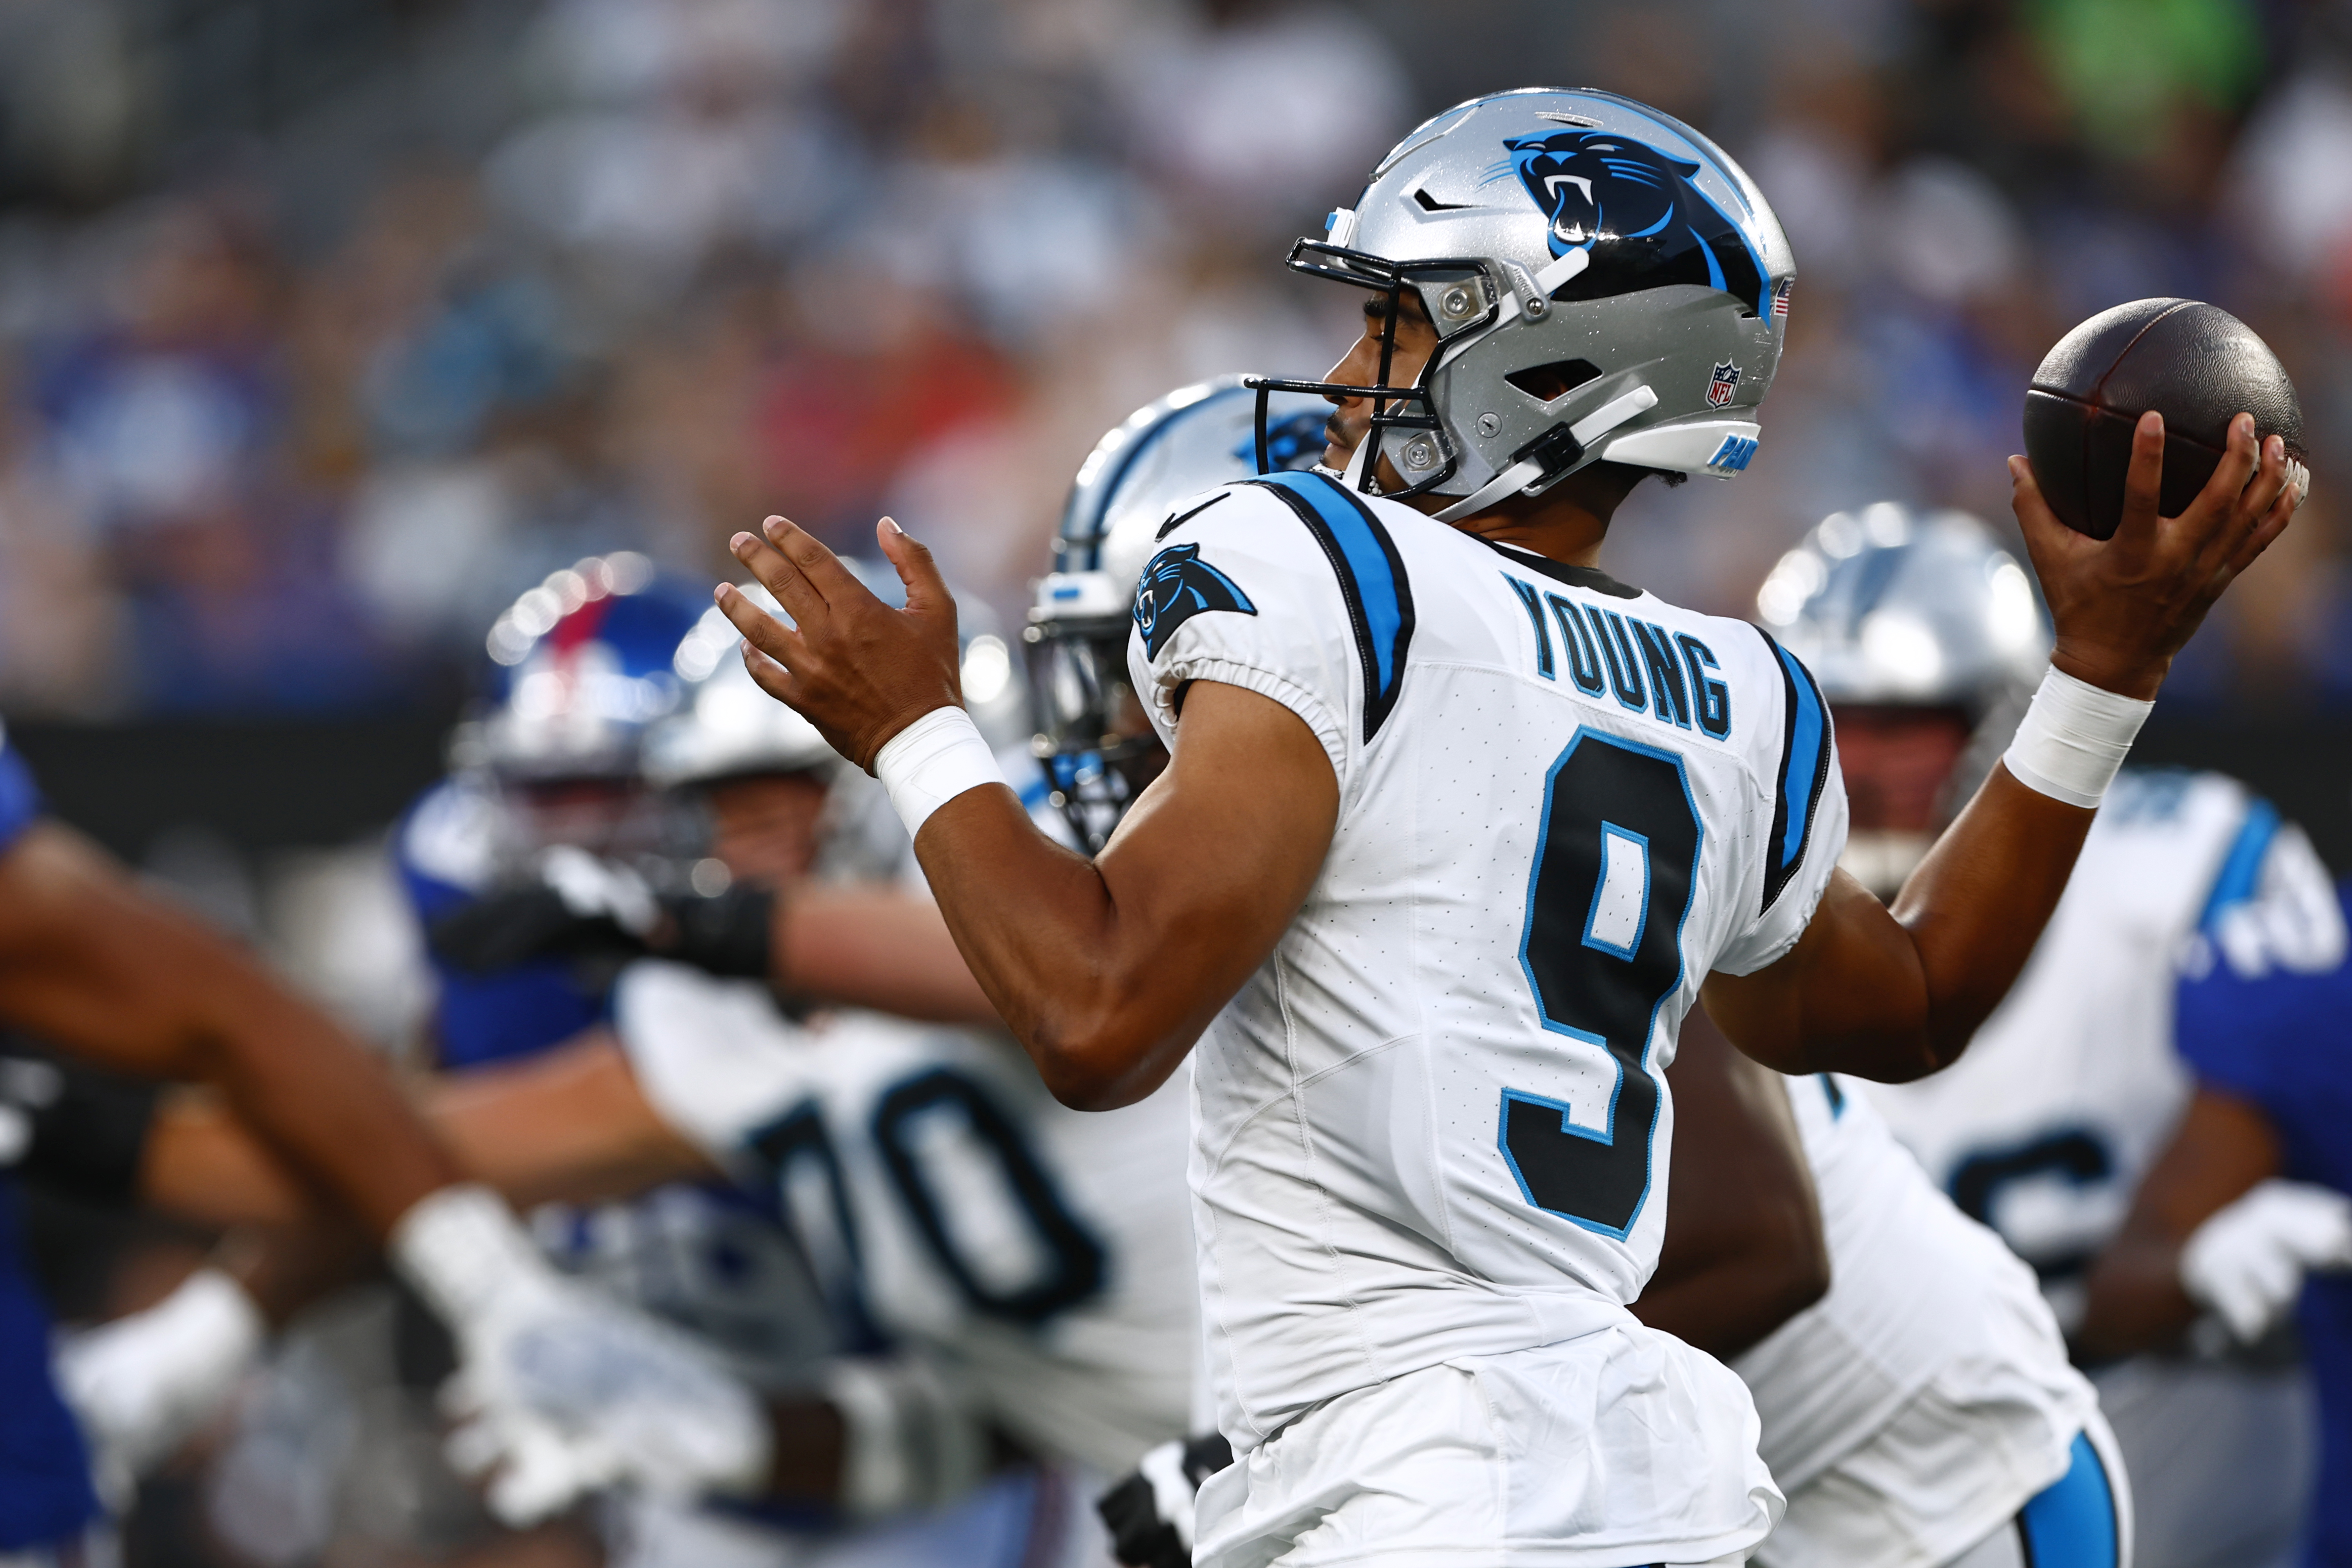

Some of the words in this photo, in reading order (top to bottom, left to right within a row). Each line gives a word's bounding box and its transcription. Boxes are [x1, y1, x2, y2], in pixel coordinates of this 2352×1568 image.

[1709, 381, 1732, 404] NFL
[1498, 570, 1732, 742] YOUNG
[1497, 724, 1704, 1242] 9
